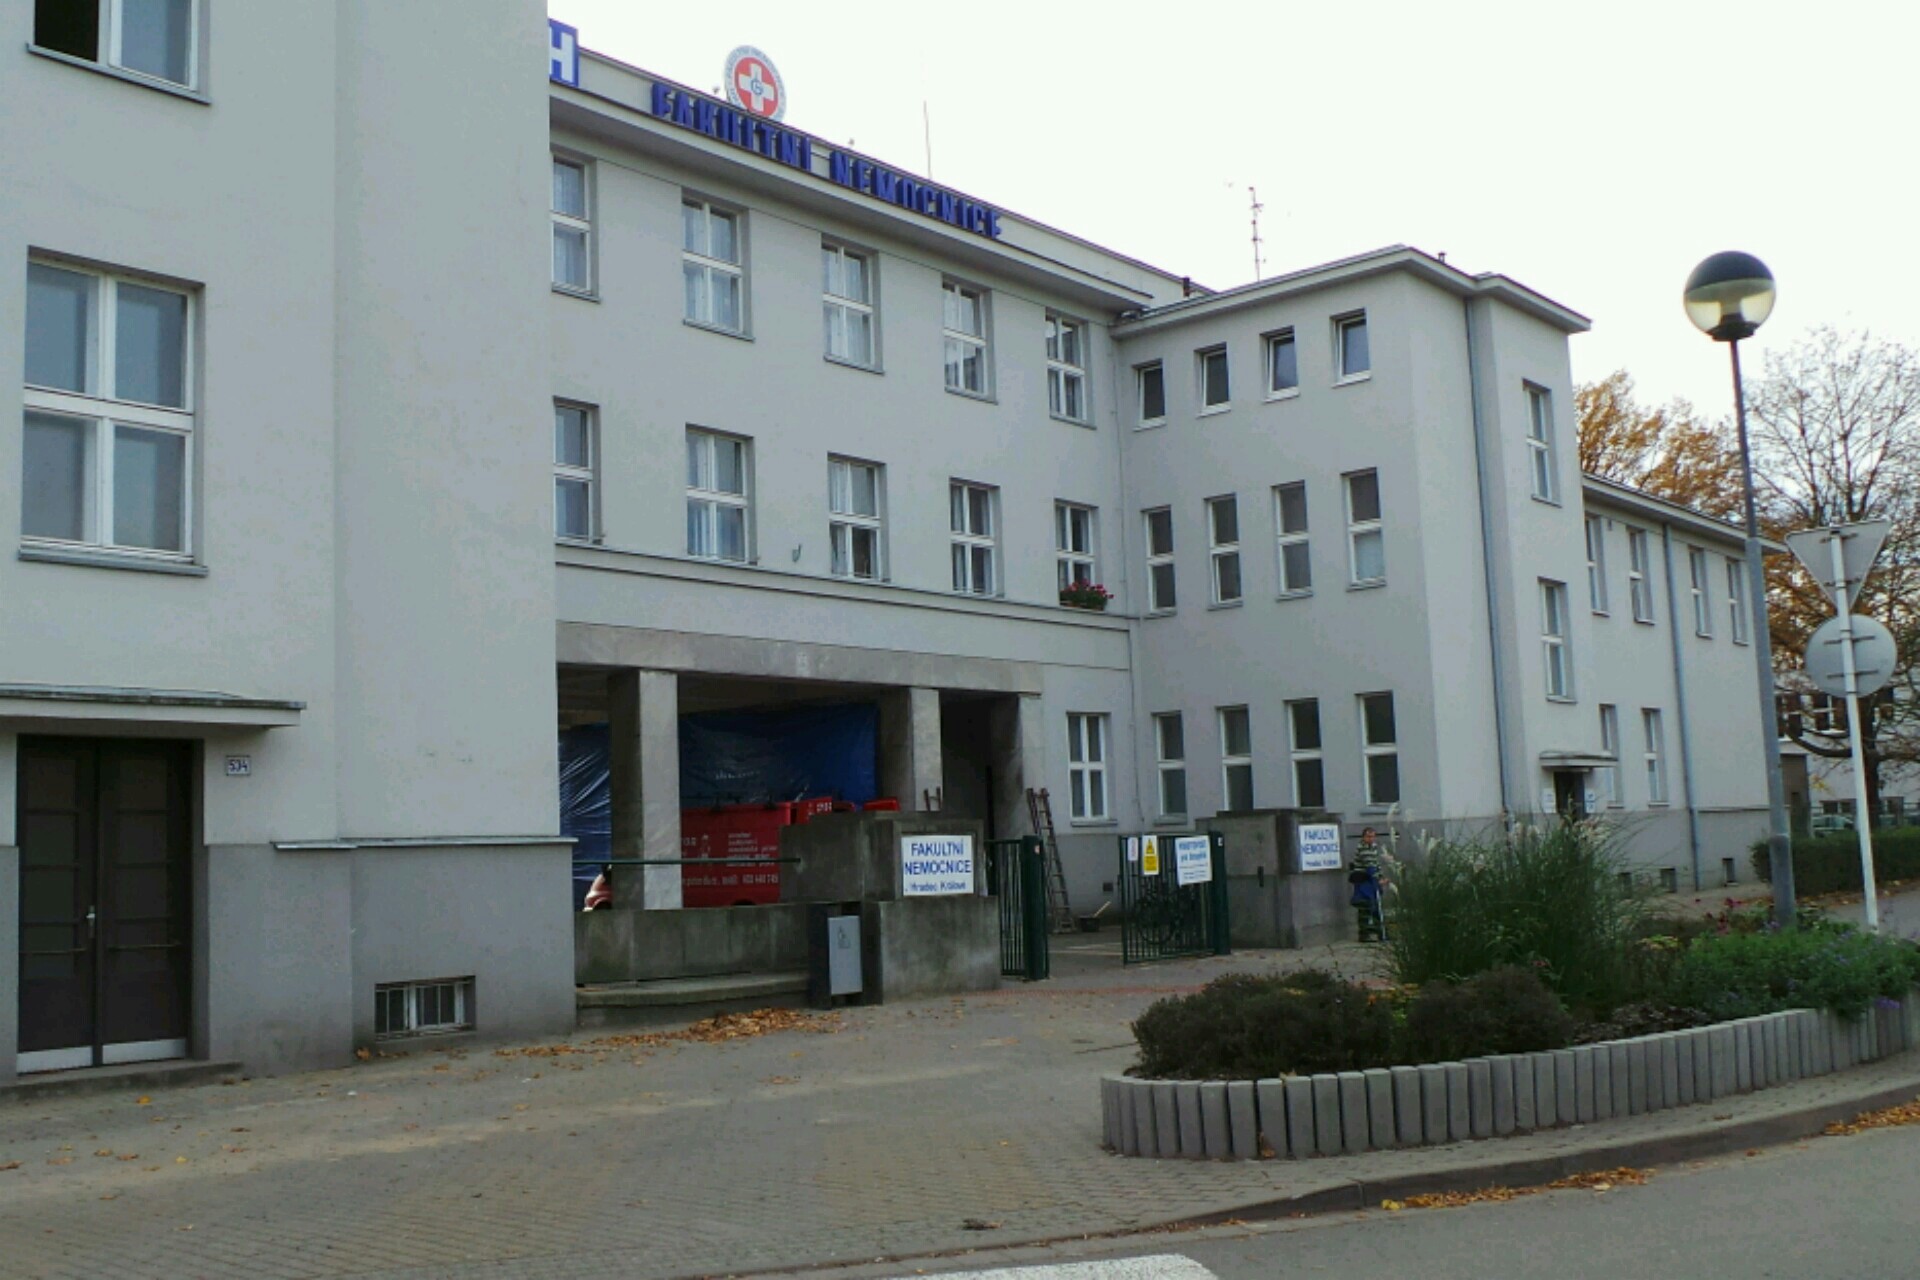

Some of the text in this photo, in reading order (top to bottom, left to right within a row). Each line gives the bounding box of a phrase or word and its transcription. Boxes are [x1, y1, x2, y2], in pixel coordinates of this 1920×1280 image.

[549, 26, 575, 83] H
[830, 150, 1002, 239] NEMOCNICE
[911, 838, 964, 856] FAKULTNÍ
[905, 860, 972, 875] NEMOCNICE
